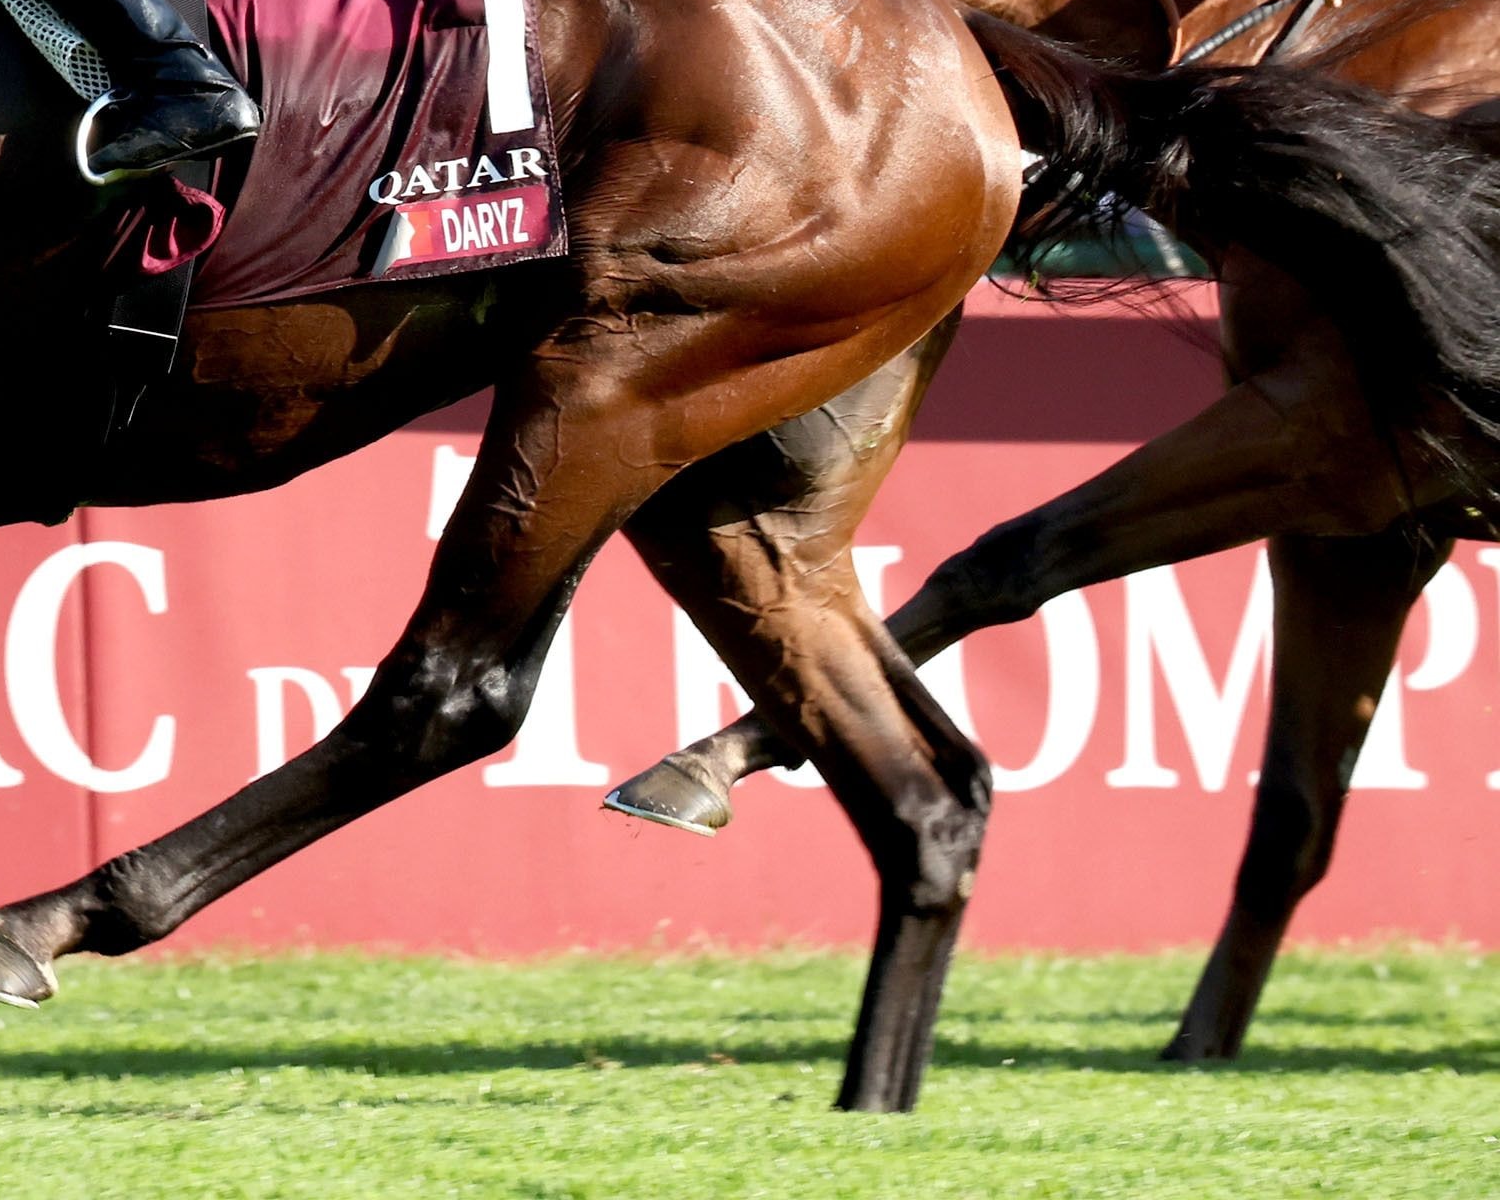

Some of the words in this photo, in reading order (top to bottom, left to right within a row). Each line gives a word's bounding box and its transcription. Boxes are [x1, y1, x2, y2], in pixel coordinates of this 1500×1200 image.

[368, 147, 550, 206] QATAR
[440, 197, 530, 253] DARYZ
[245, 665, 379, 783] D
